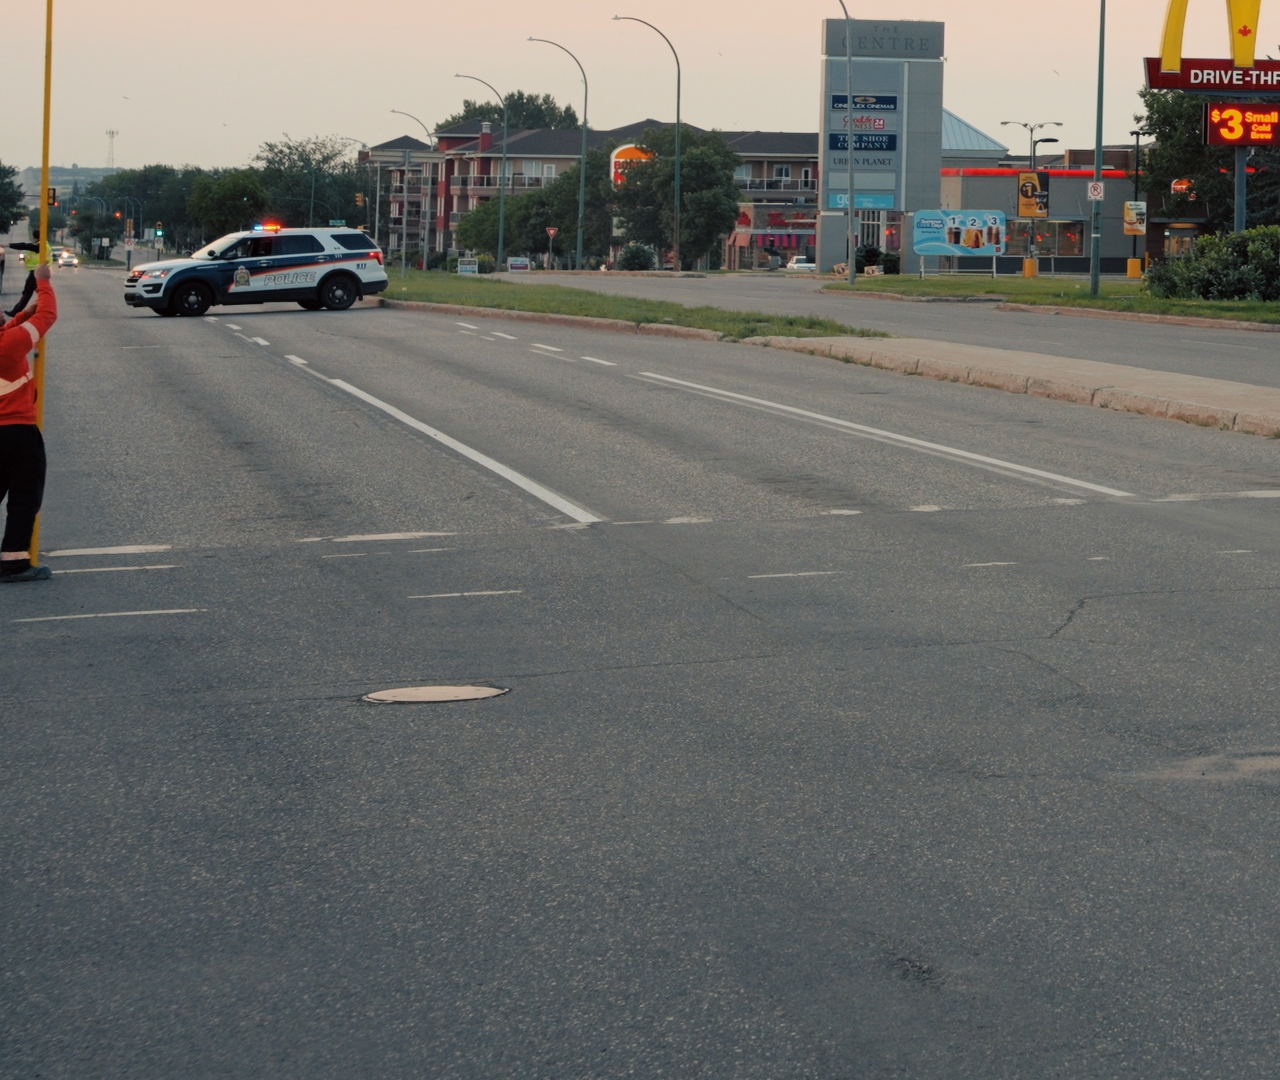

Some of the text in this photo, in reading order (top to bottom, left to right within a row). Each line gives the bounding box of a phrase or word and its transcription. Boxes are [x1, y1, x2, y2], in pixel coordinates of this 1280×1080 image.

[873, 25, 899, 34] THE
[842, 36, 930, 52] CENTRE
[1245, 111, 1279, 123] Small
[1251, 123, 1272, 132] Cold
[1250, 131, 1273, 139] Brew
[833, 157, 893, 166] URBN PLANET
[263, 271, 317, 287] POLICE
